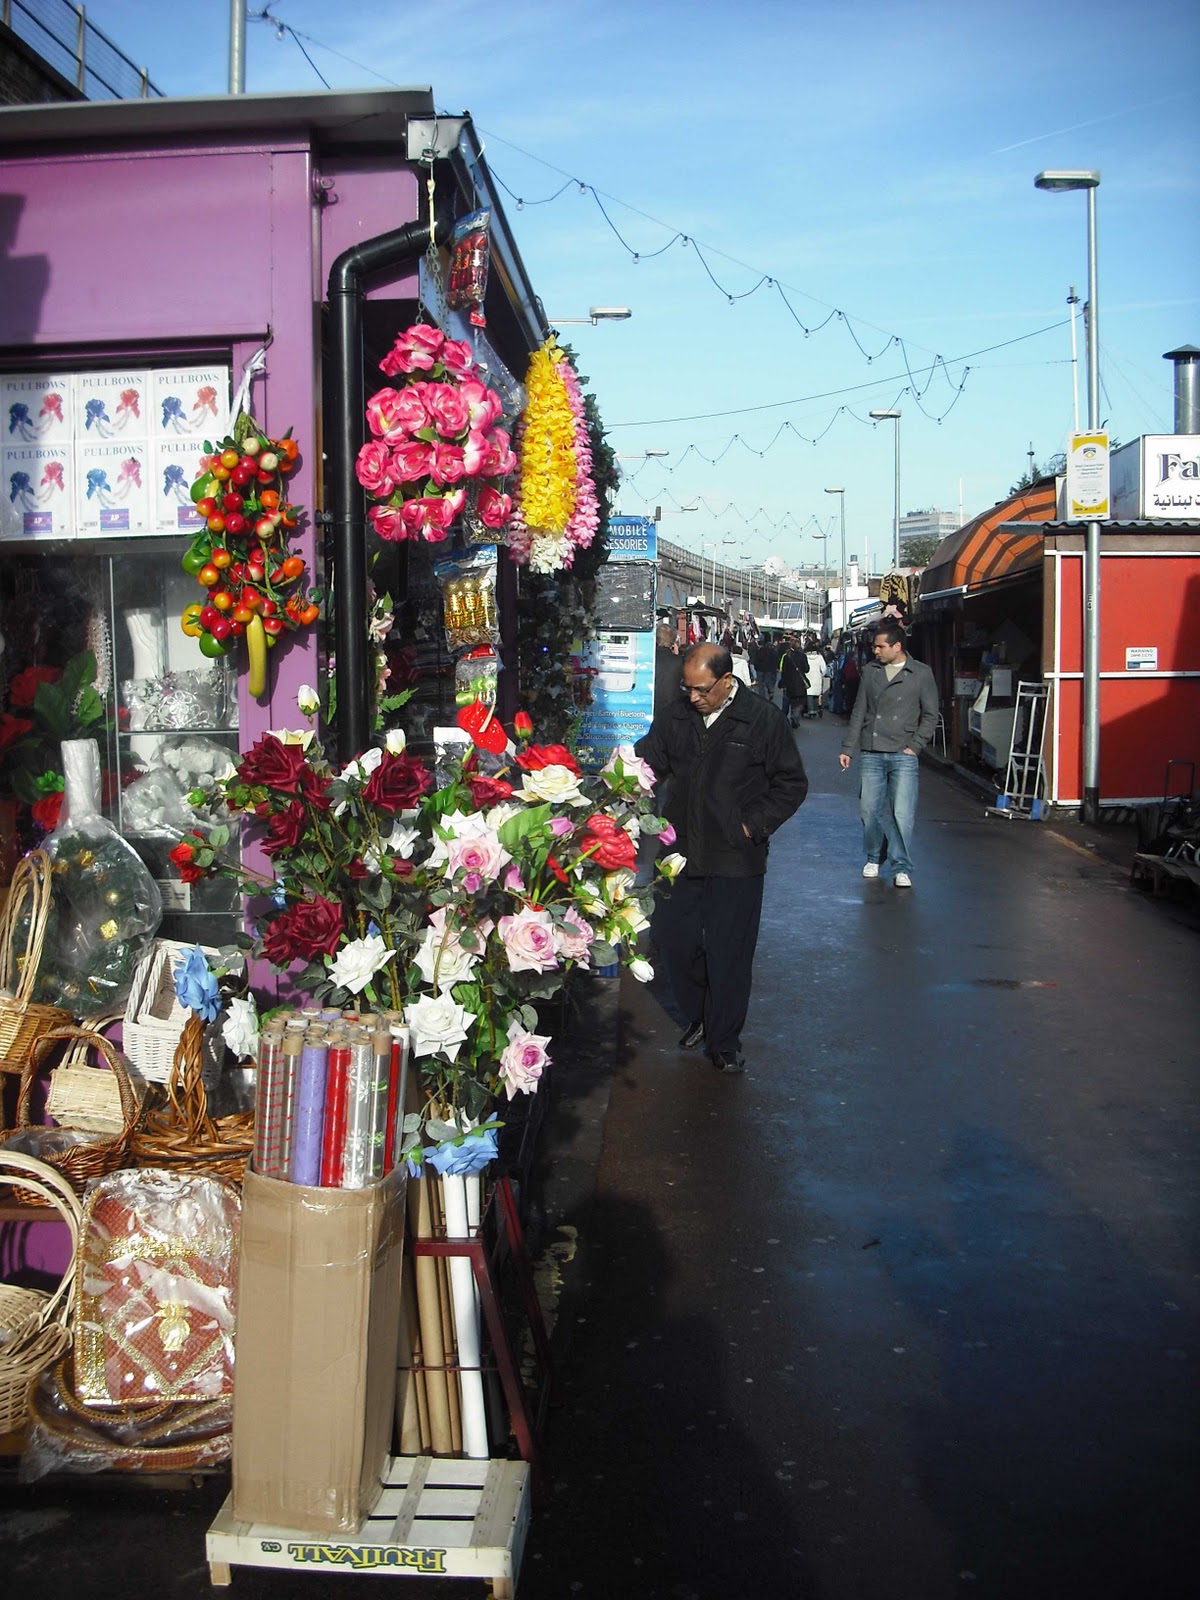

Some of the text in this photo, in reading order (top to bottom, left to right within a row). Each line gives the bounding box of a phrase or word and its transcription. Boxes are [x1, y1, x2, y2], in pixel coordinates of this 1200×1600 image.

[82, 376, 143, 387] PULLBOWS
[158, 373, 220, 385] PULLBOWS
[6, 381, 66, 392] PULLBOWS
[83, 446, 143, 457] PULLBOWS
[160, 442, 204, 453] PULLBO
[7, 449, 66, 460] PULLBOWS
[1158, 453, 1200, 483] Fa
[1153, 494, 1193, 511] لبنانية
[609, 525, 647, 536] MOBILE
[289, 1543, 446, 1573] FRUITVALL
